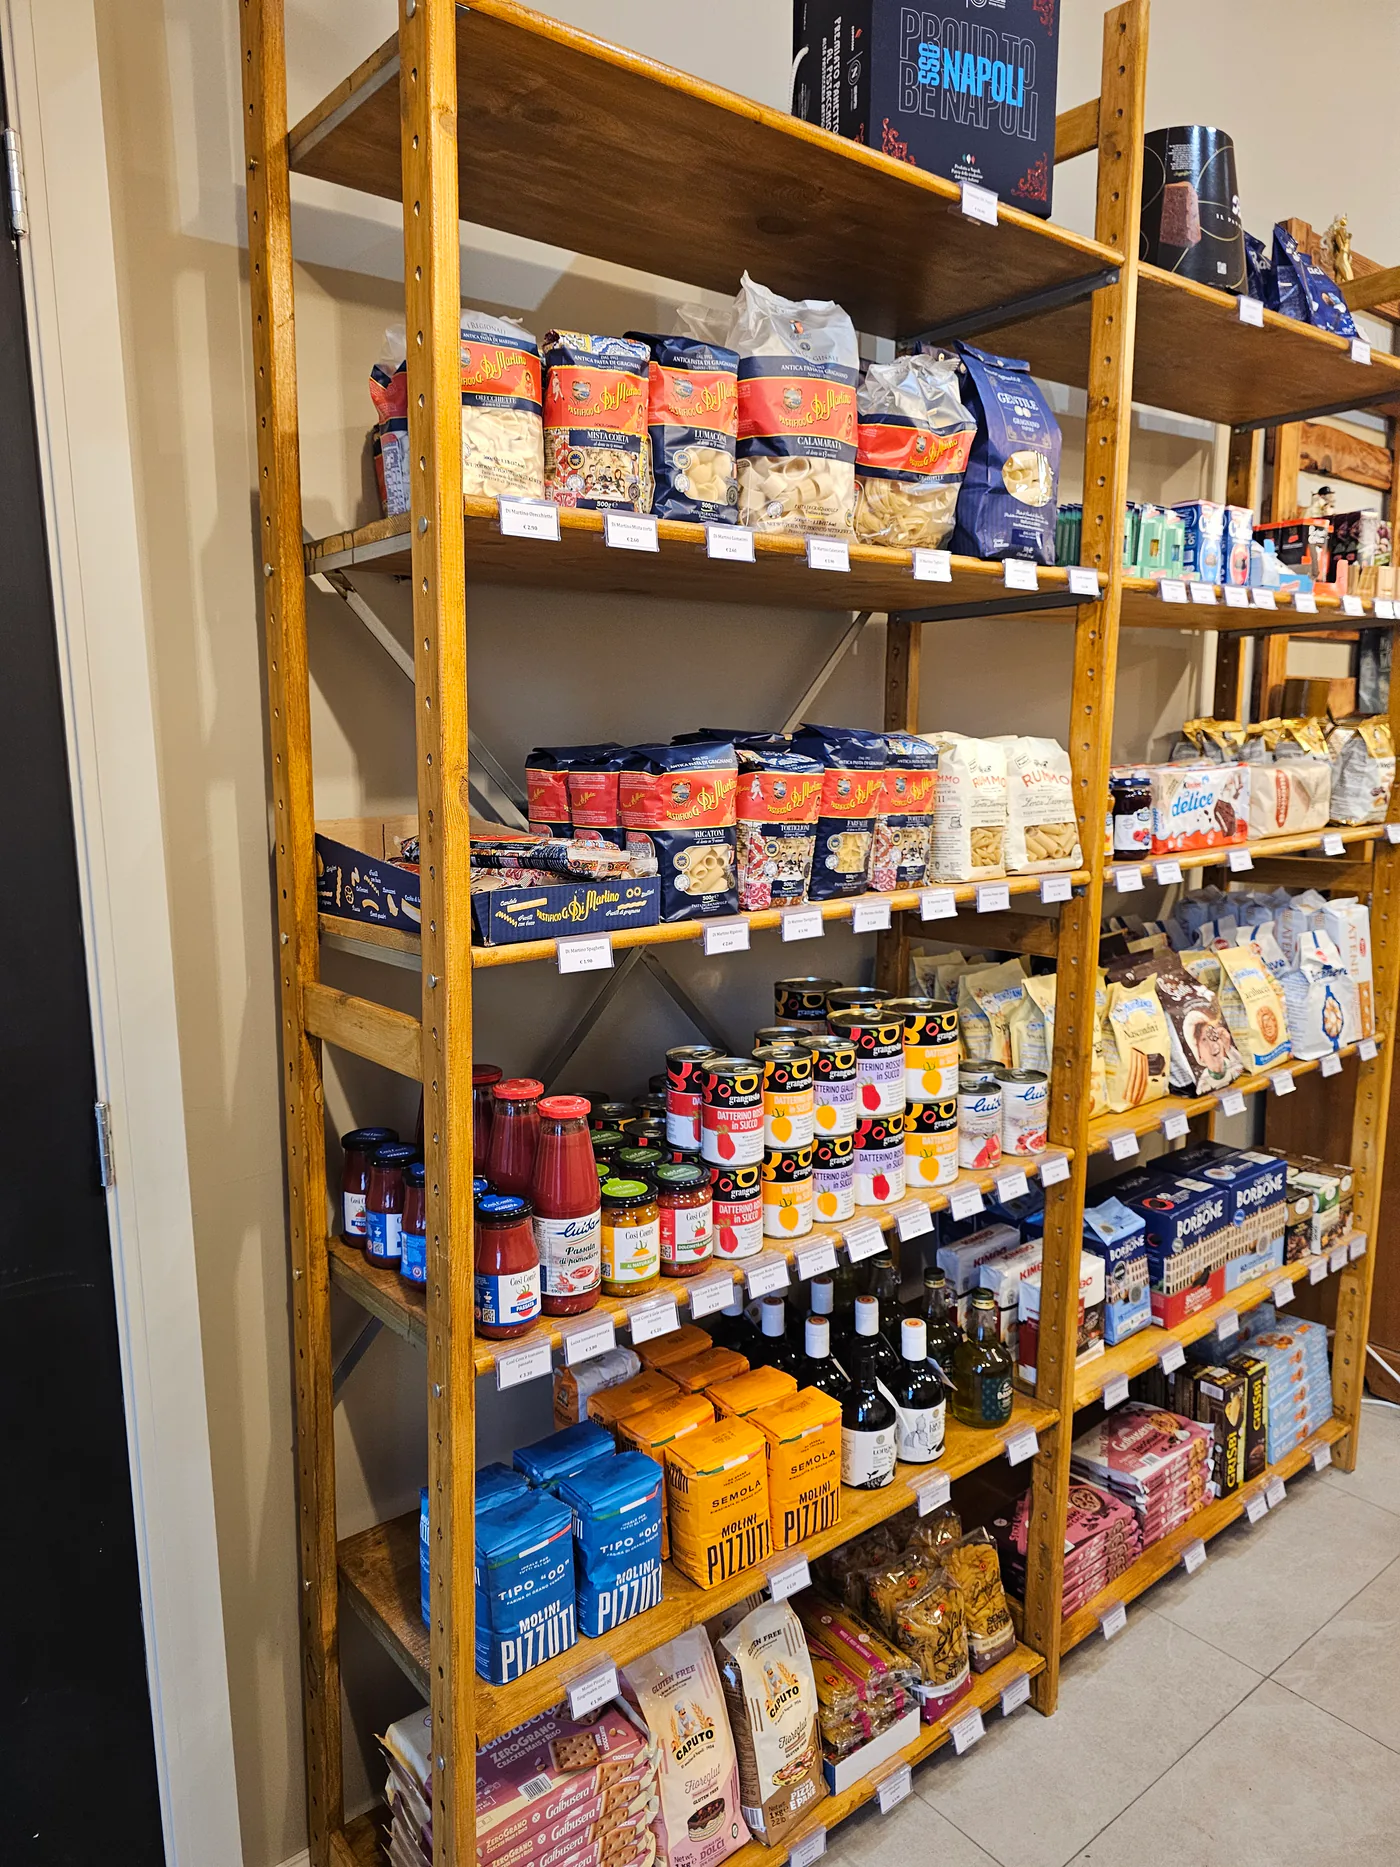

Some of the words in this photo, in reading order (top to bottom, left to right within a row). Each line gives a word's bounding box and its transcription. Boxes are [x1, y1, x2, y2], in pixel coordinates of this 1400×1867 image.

[944, 47, 1024, 108] NAPOLI
[797, 436, 842, 451] CALAMARATA
[1022, 770, 1070, 788] RUMMO
[536, 909, 561, 923] PASTIFICIO
[581, 890, 620, 921] Martino
[873, 1042, 902, 1056] grangusto
[857, 1061, 884, 1071] TTERINO
[728, 1093, 760, 1105] grangusto
[813, 1085, 839, 1094] ATTERINO
[717, 1110, 749, 1120] DATTERINO
[732, 1122, 739, 1130] in
[740, 1120, 758, 1130] SUCCO
[860, 1152, 892, 1162] DATTERINO
[813, 1172, 839, 1181] ATTERINO
[730, 1185, 760, 1198] grangusto
[1236, 1172, 1283, 1208] BORBONE
[719, 1204, 751, 1214] DATTERINO
[734, 1215, 741, 1223] in
[742, 1211, 759, 1222] SUCCO
[1176, 1199, 1223, 1238] BORBONE
[565, 1243, 596, 1256] Passata
[1110, 1234, 1145, 1262] BORBONE
[510, 1276, 522, 1286] Così
[1020, 1262, 1042, 1280] KIMB
[516, 1302, 535, 1312] PASSATA
[791, 1449, 836, 1474] SEMOLA
[712, 1479, 761, 1508] SEMOLA
[799, 1481, 831, 1504] MOLINI
[722, 1513, 757, 1538] MOLINI
[785, 1487, 839, 1547] PIZZUTI
[600, 1536, 634, 1554] TIPO
[707, 1520, 770, 1585] PIZZUTI
[616, 1558, 654, 1586] MOLINI
[498, 1580, 534, 1600] TIPO
[597, 1563, 662, 1635] PIZZUTI
[519, 1600, 560, 1634] MOLINI
[501, 1603, 576, 1683] PIZZUTI
[764, 1629, 782, 1642] FREE
[725, 1659, 740, 1668] CAPU
[652, 1674, 675, 1694] GLUTEN
[675, 1664, 696, 1678] FREE
[770, 1686, 799, 1718] CAPUTO
[676, 1730, 714, 1761] CAPUTO
[790, 1780, 814, 1799] PIZZA
[797, 1788, 816, 1808] PANE
[546, 1786, 589, 1820] Galbusera
[551, 1808, 595, 1841] Galbusera
[700, 1838, 725, 1860] DOLCI
